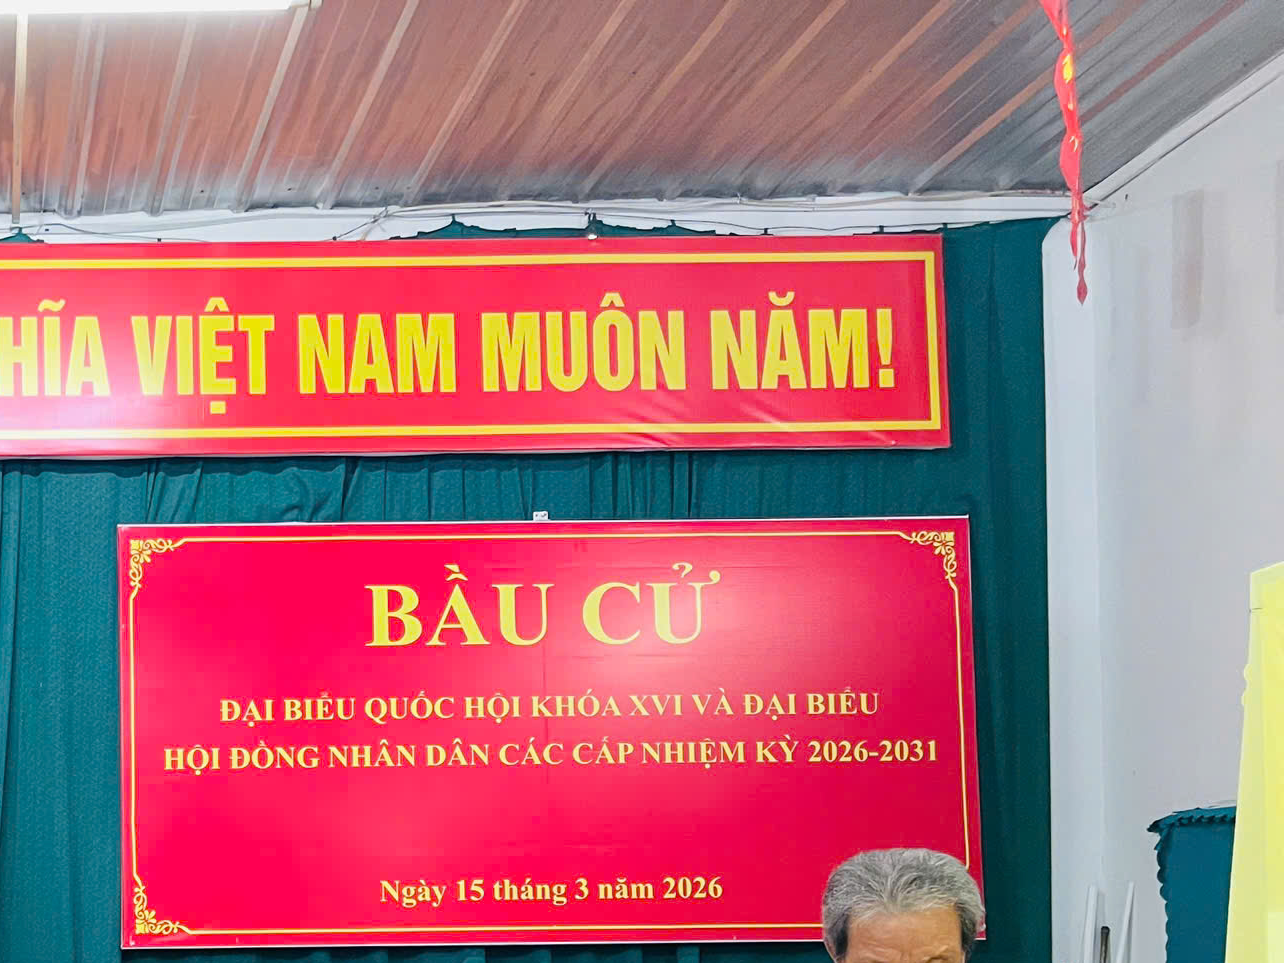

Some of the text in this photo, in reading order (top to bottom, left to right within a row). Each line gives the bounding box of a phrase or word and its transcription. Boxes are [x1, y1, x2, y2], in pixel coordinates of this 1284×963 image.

[132, 297, 276, 415] VIỆT
[298, 312, 458, 396] NAM
[482, 293, 687, 393] MUÔN
[712, 291, 896, 392] NĂM!
[364, 562, 722, 648] BẦU CỬ
[219, 698, 275, 728] ĐẠI
[364, 690, 455, 725] QUỐC
[463, 693, 521, 724] HỘI
[532, 689, 622, 719] KHÓA
[629, 694, 683, 717] XVI
[691, 688, 735, 716] VÀ
[742, 692, 798, 721] ĐẠI
[163, 734, 938, 776] HỘI ĐỒNG NHÂN DÂN CÁC CẤP NHIỆM KỲ 2026-2031
[380, 876, 724, 908] Ngày 15 tháng 3 năm 2026
